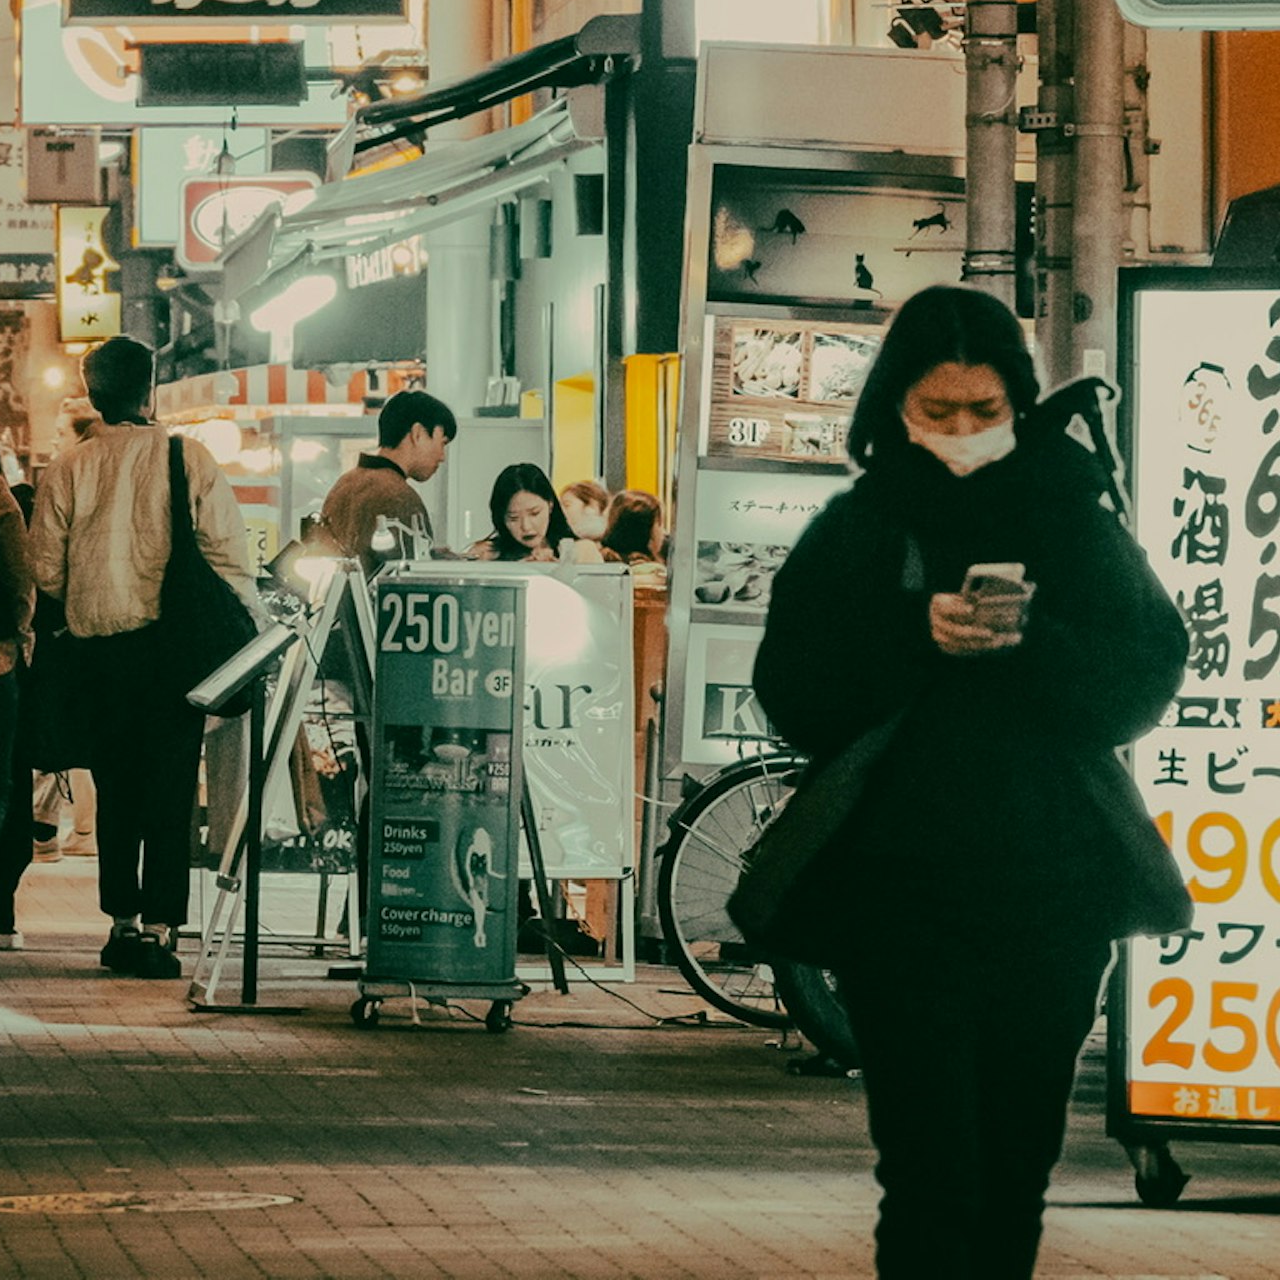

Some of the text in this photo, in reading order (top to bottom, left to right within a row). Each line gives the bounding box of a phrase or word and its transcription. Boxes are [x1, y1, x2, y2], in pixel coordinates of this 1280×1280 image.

[380, 592, 516, 659] 250 yen
[432, 658, 511, 696] Bar 3F
[383, 824, 428, 840] Drinks
[383, 842, 423, 856] 250yen
[382, 864, 411, 880] Food
[380, 906, 472, 928] Cover charge
